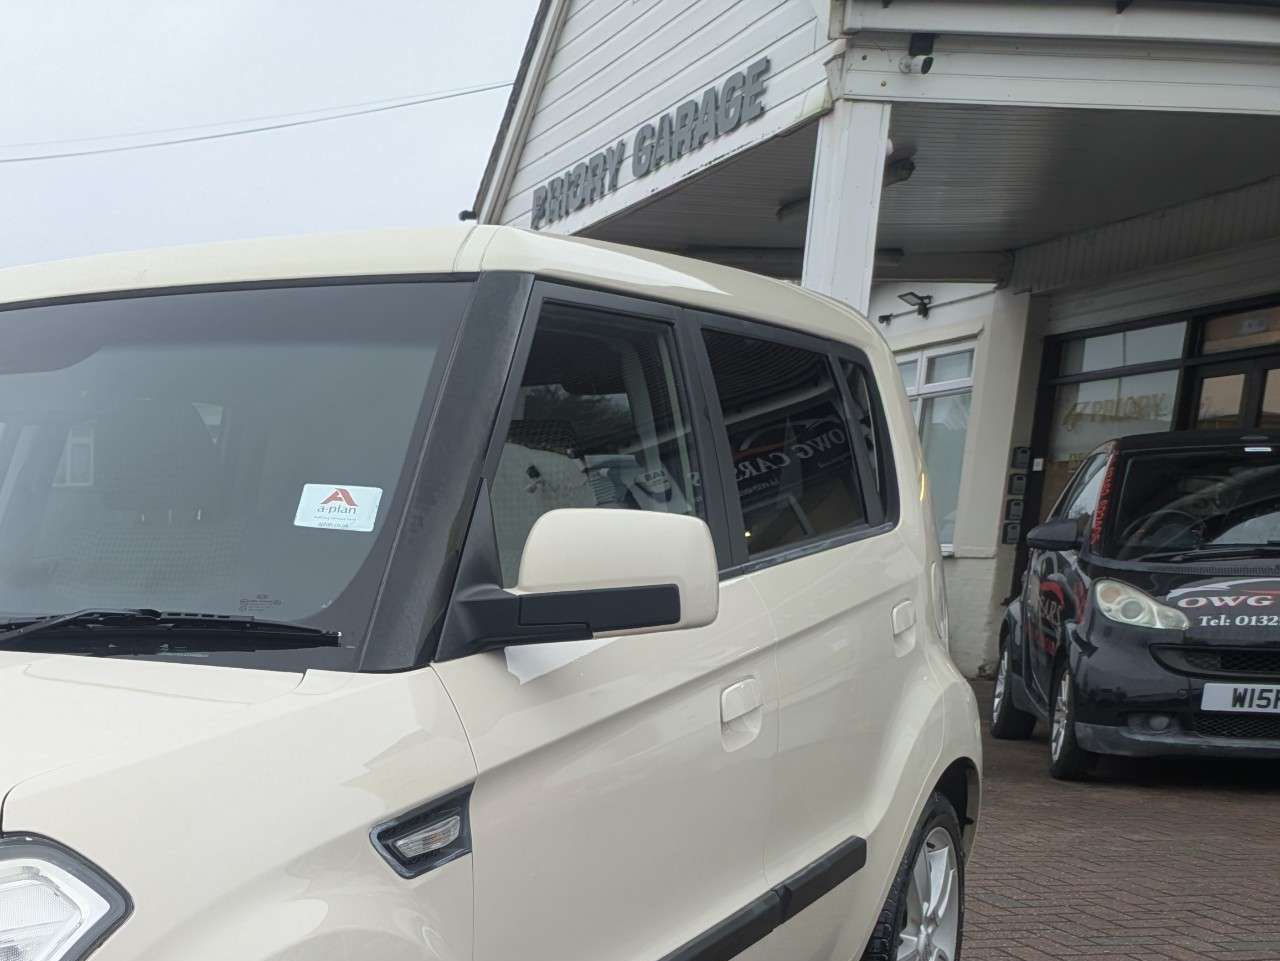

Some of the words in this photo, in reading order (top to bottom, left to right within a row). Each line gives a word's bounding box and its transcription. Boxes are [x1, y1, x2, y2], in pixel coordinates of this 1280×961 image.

[530, 139, 626, 230] PRIORY
[632, 55, 772, 178] GARAGE
[1177, 595, 1274, 608] OWG
[1200, 614, 1231, 627] Tel:
[1235, 615, 1280, 626] 0132
